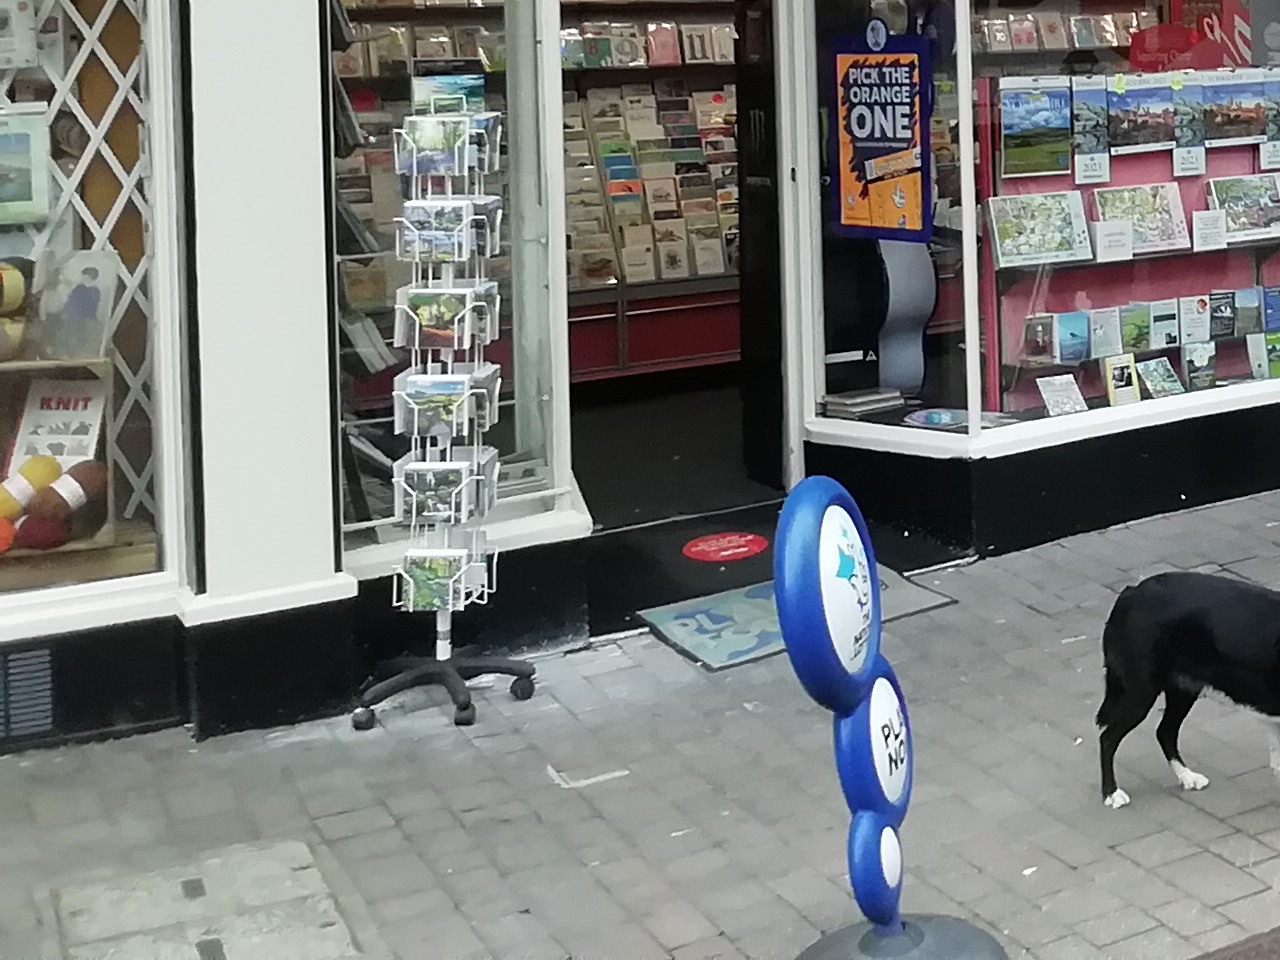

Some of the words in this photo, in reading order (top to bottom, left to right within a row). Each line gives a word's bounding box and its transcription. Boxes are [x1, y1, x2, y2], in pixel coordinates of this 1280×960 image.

[849, 67, 880, 84] PICK
[883, 67, 911, 84] THE
[849, 86, 911, 104] ORANGE
[850, 105, 913, 139] ONE
[40, 396, 93, 411] KNIT
